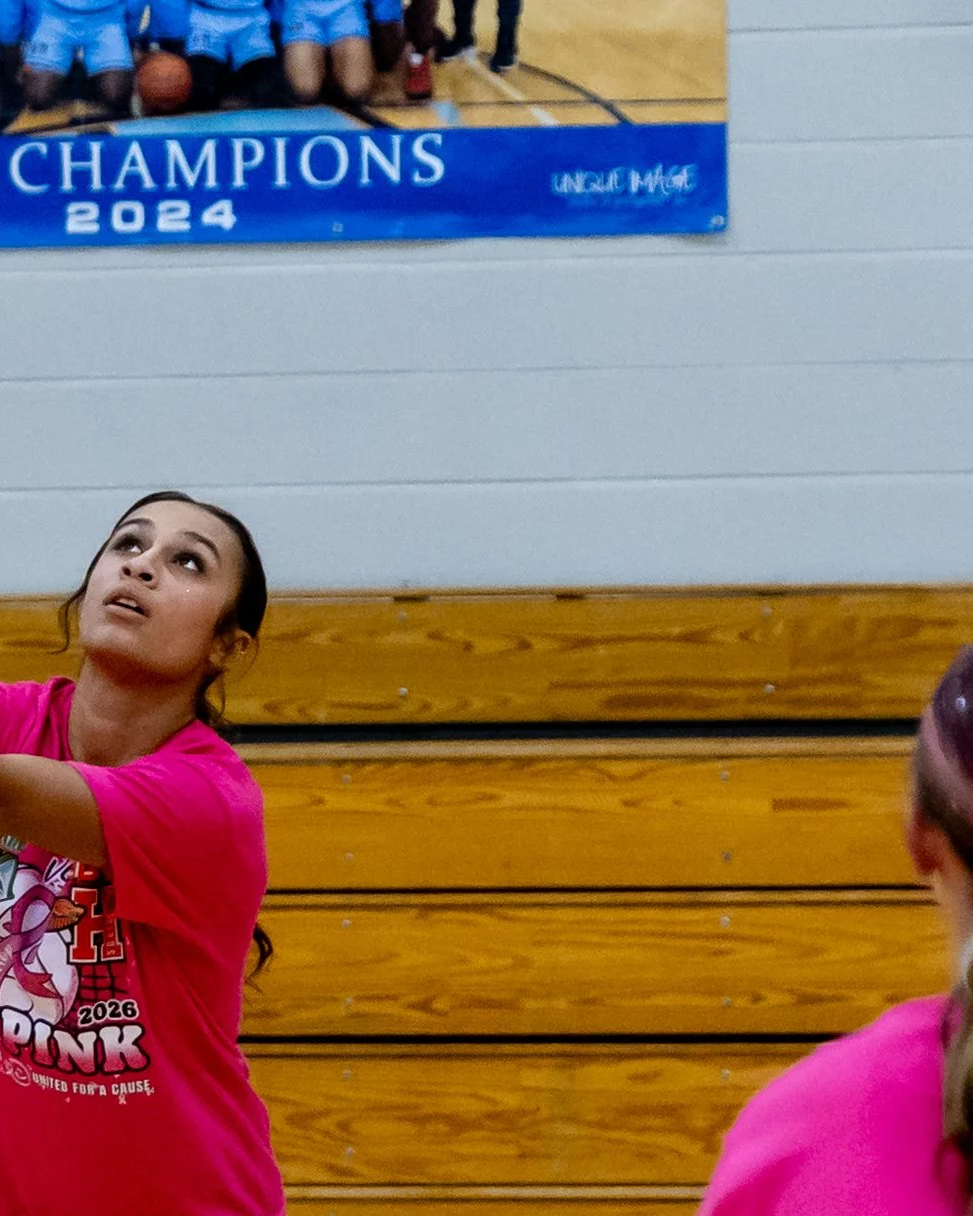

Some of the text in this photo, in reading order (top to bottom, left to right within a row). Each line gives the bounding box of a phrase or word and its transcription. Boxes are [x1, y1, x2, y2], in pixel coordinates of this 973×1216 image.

[9, 132, 446, 194] CHAMPIONS
[64, 199, 237, 234] 2024
[78, 1000, 138, 1026] 2026
[0, 1006, 151, 1076] PINK
[32, 1071, 68, 1093] UNITED
[72, 1081, 94, 1096] FOR
[98, 1083, 108, 1096] A
